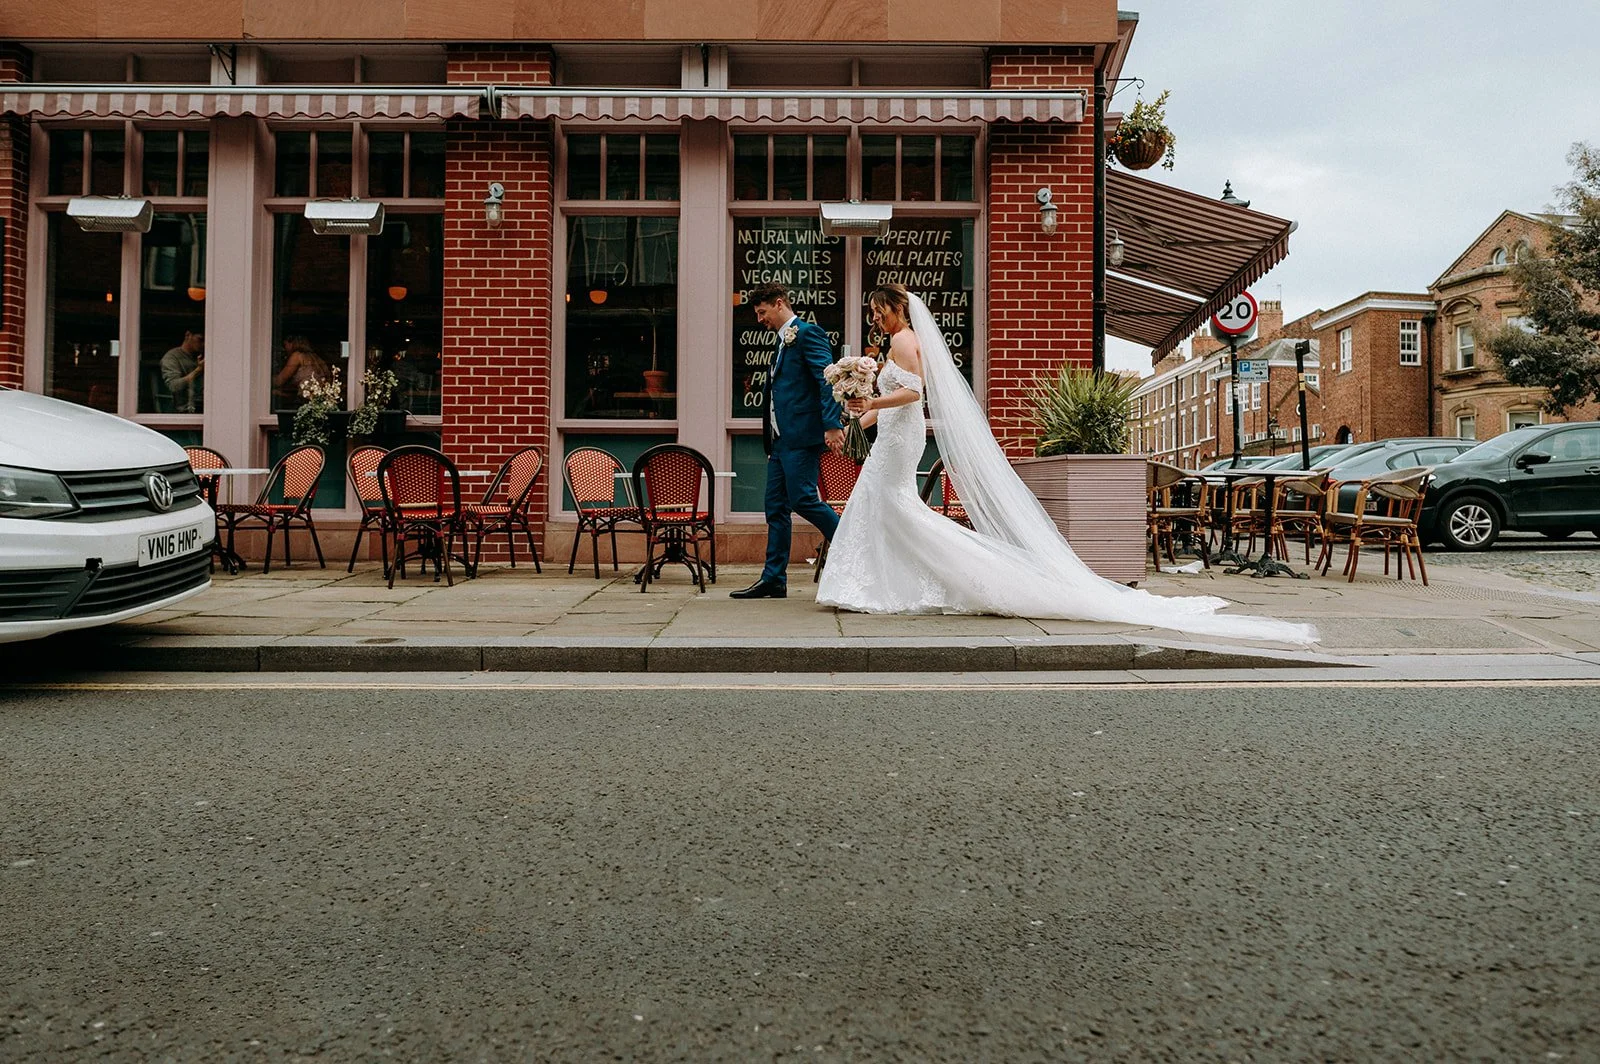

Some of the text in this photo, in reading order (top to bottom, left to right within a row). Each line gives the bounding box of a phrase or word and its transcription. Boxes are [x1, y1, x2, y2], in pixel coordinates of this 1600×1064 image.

[738, 230, 793, 245] NATURAL
[874, 230, 952, 245] APERITIF
[745, 250, 831, 264] CASK ALES
[866, 250, 963, 267] SMALL PLATES
[741, 269, 832, 284] VEGAN PIES
[876, 271, 945, 287] BRUNCH
[787, 290, 837, 305] GAMES
[942, 291, 968, 307] TEA
[1220, 301, 1251, 319] 20
[740, 330, 778, 346] SUND
[1242, 362, 1249, 371] P
[147, 528, 198, 560] VN16 HNP
